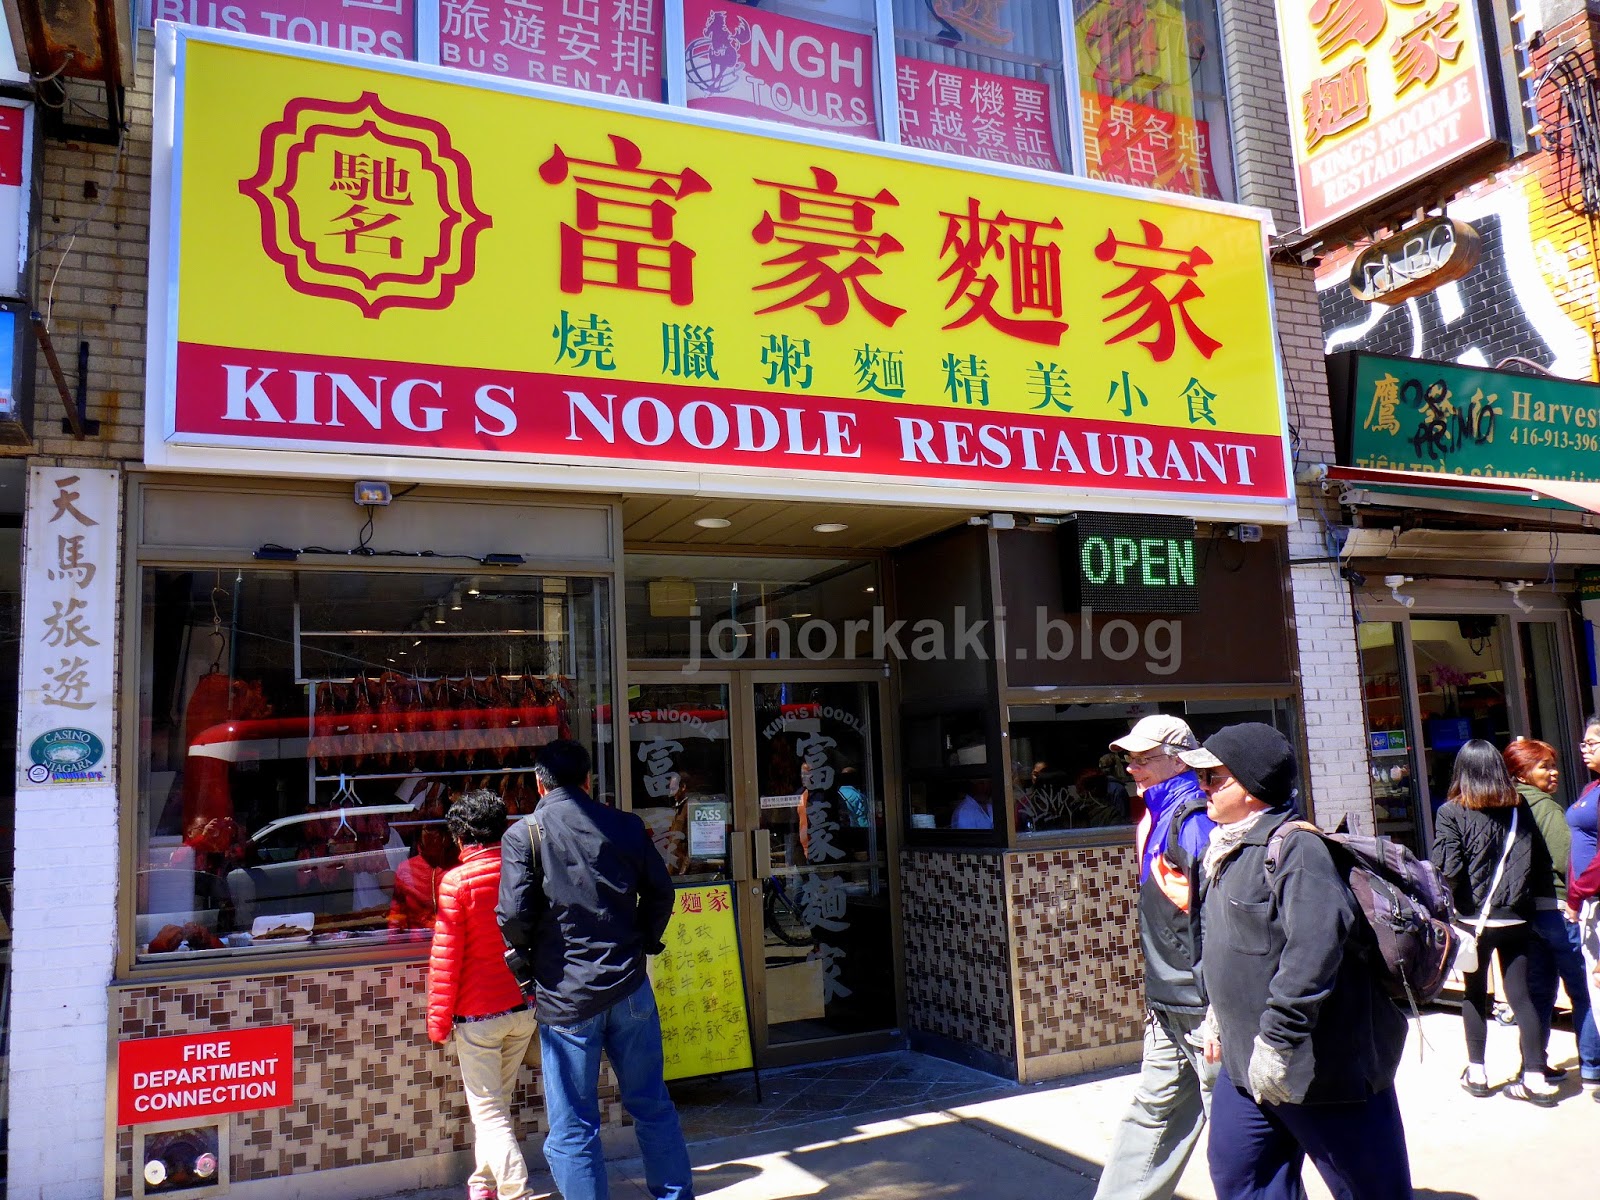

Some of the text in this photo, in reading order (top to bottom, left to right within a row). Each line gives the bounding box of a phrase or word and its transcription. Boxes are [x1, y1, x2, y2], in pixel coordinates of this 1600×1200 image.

[157, 0, 404, 60] BUS TOURS
[442, 0, 655, 78] 旅遊安排
[443, 42, 652, 100] BUS RENTAL
[751, 24, 863, 88] NGH
[746, 76, 868, 126] TOURS
[900, 132, 957, 153] CHINA
[969, 145, 1054, 169] VIETNAM
[1309, 77, 1473, 187] KING'S NOODLE
[1322, 112, 1462, 208] RESTAURANT
[323, 149, 415, 260] 馳名
[539, 134, 1223, 362] 富豪麵家
[551, 309, 1219, 428] 燒臘粥麵精美小食
[563, 391, 861, 458] NOODLE
[895, 417, 1256, 486] RESTAURANT
[1509, 426, 1600, 452] 416-913-396
[1081, 536, 1196, 586] OPEN
[40, 475, 100, 711] 天馬旅遊
[43, 730, 92, 743] CASINO
[656, 708, 720, 743] NOODLE
[762, 707, 809, 741] KING'S
[42, 758, 93, 773] NIAGARA
[694, 809, 722, 821] PASS
[671, 889, 730, 914] 麵家
[133, 1058, 279, 1090] DEPARTMENT
[183, 1041, 231, 1062] FIRE
[134, 1080, 277, 1113] CONNECTION
